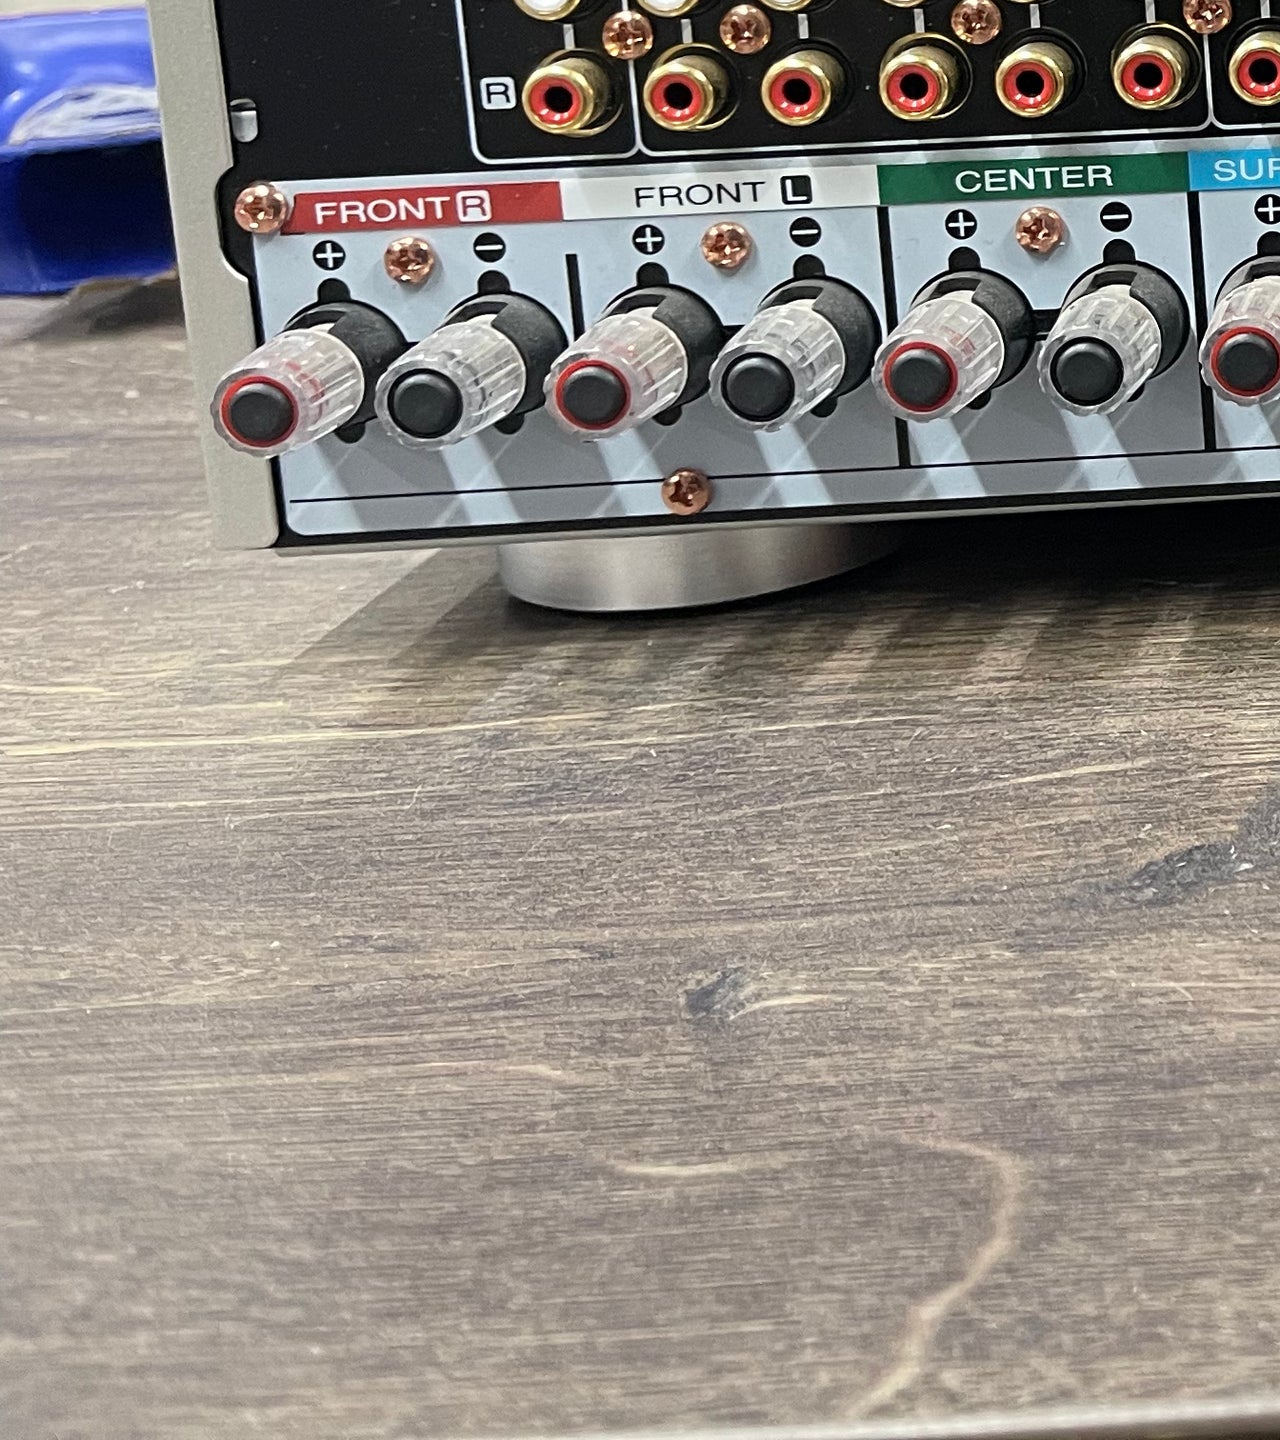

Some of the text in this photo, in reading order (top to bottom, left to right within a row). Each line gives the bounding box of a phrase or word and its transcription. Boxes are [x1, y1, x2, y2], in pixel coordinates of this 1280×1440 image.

[955, 166, 1113, 193] CENTER
[635, 182, 765, 208] FRONT
[315, 197, 450, 224] FRONT
